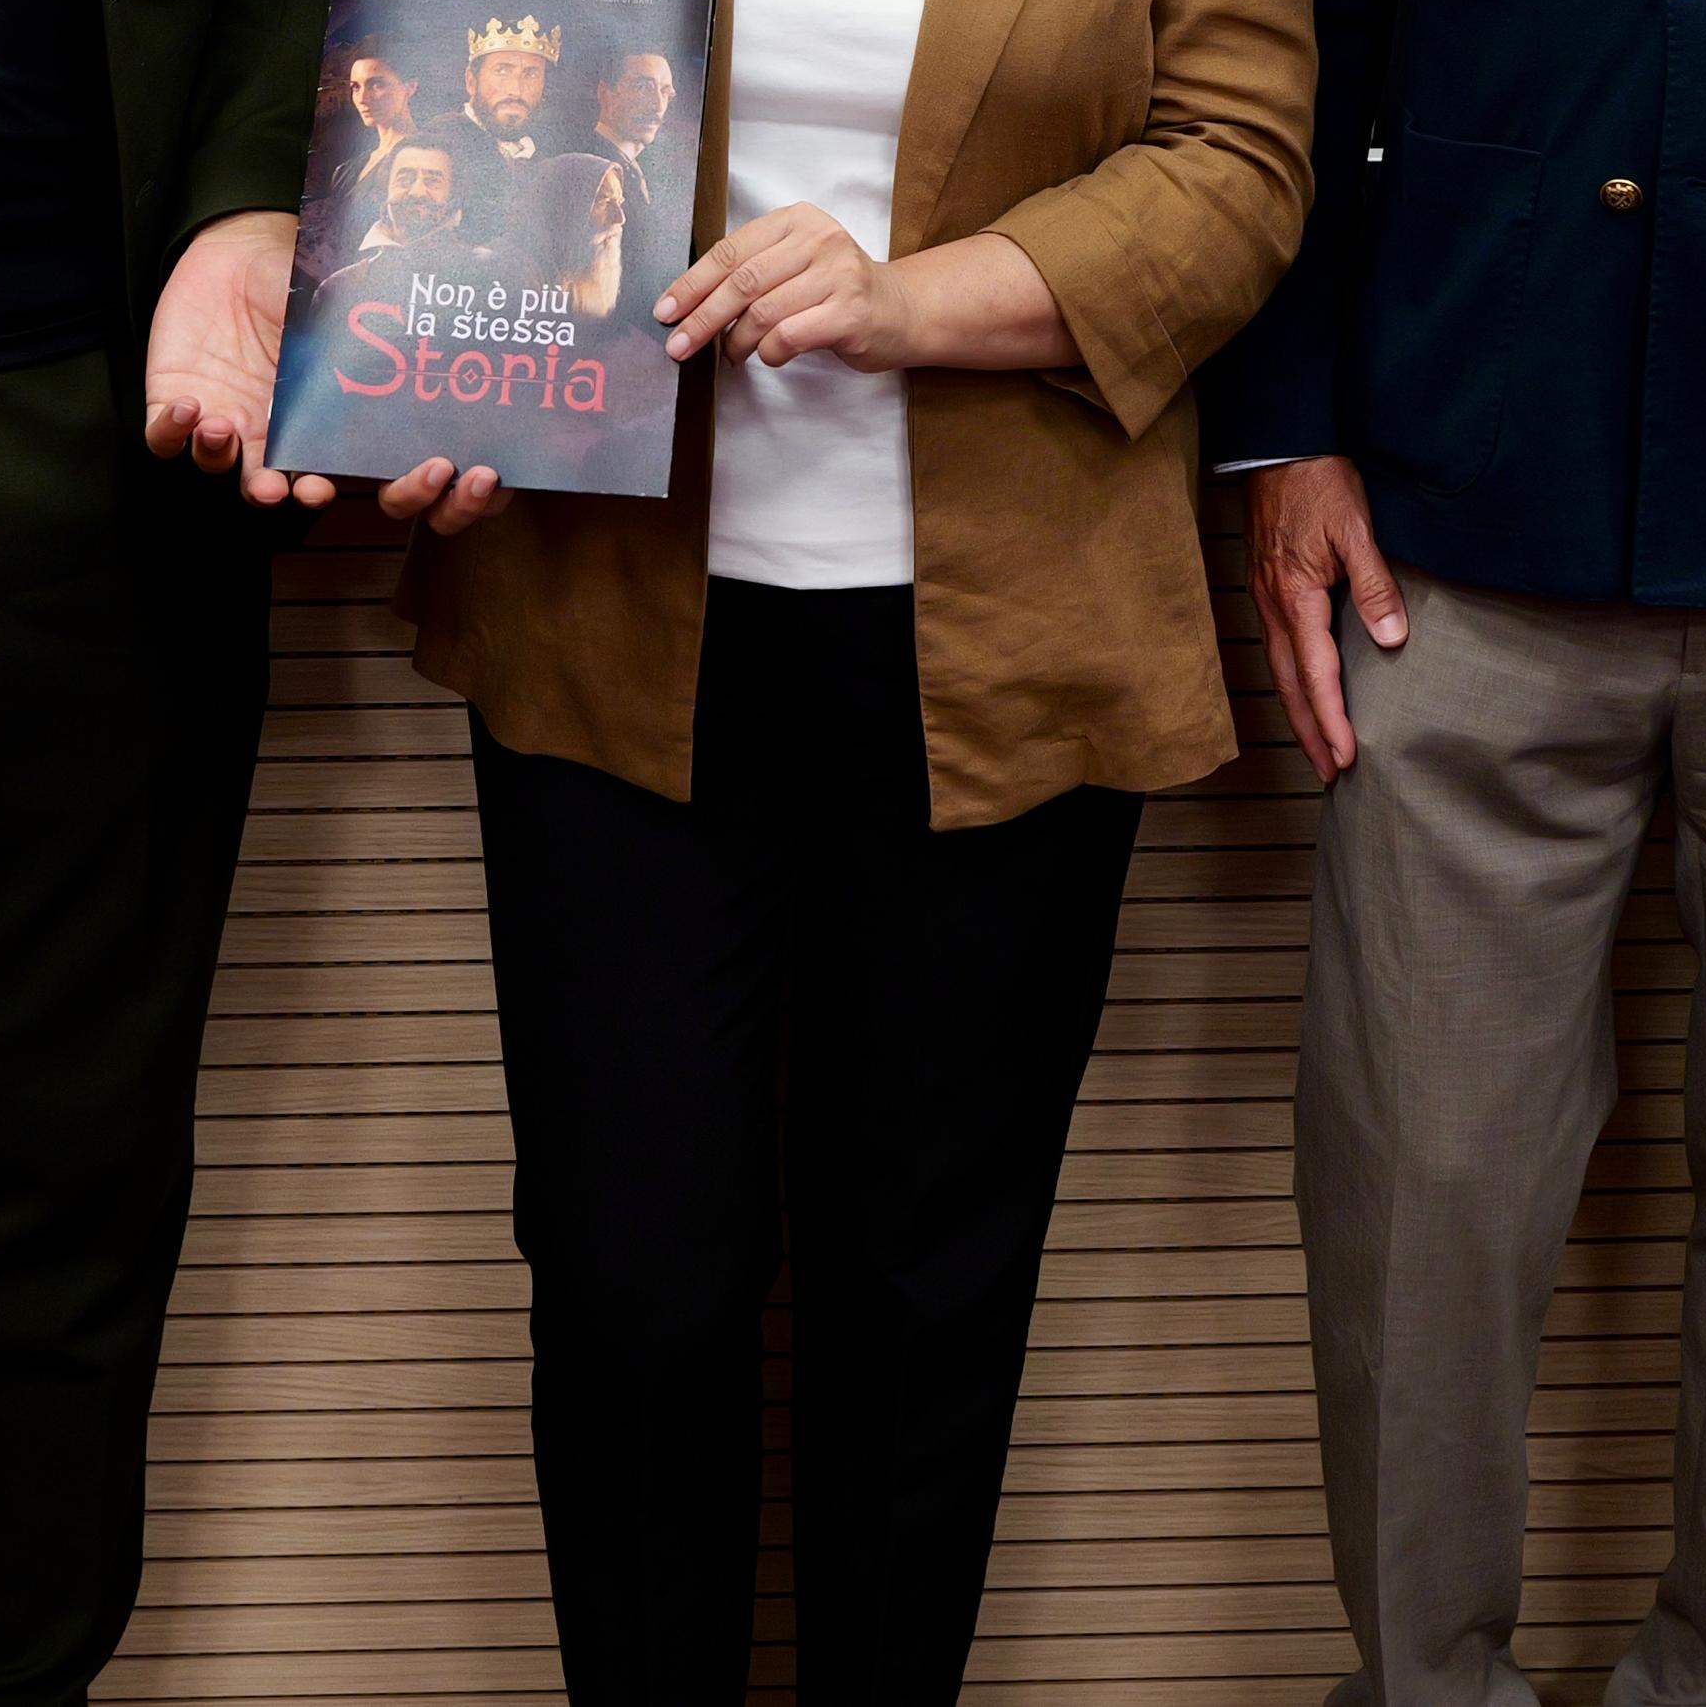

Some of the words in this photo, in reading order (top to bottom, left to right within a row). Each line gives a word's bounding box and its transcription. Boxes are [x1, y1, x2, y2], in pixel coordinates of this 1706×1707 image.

[410, 273, 476, 316] Non
[487, 281, 507, 310] è
[520, 284, 570, 319] più
[405, 304, 436, 336] la
[451, 310, 575, 346] stessa
[334, 301, 606, 412] Storia
